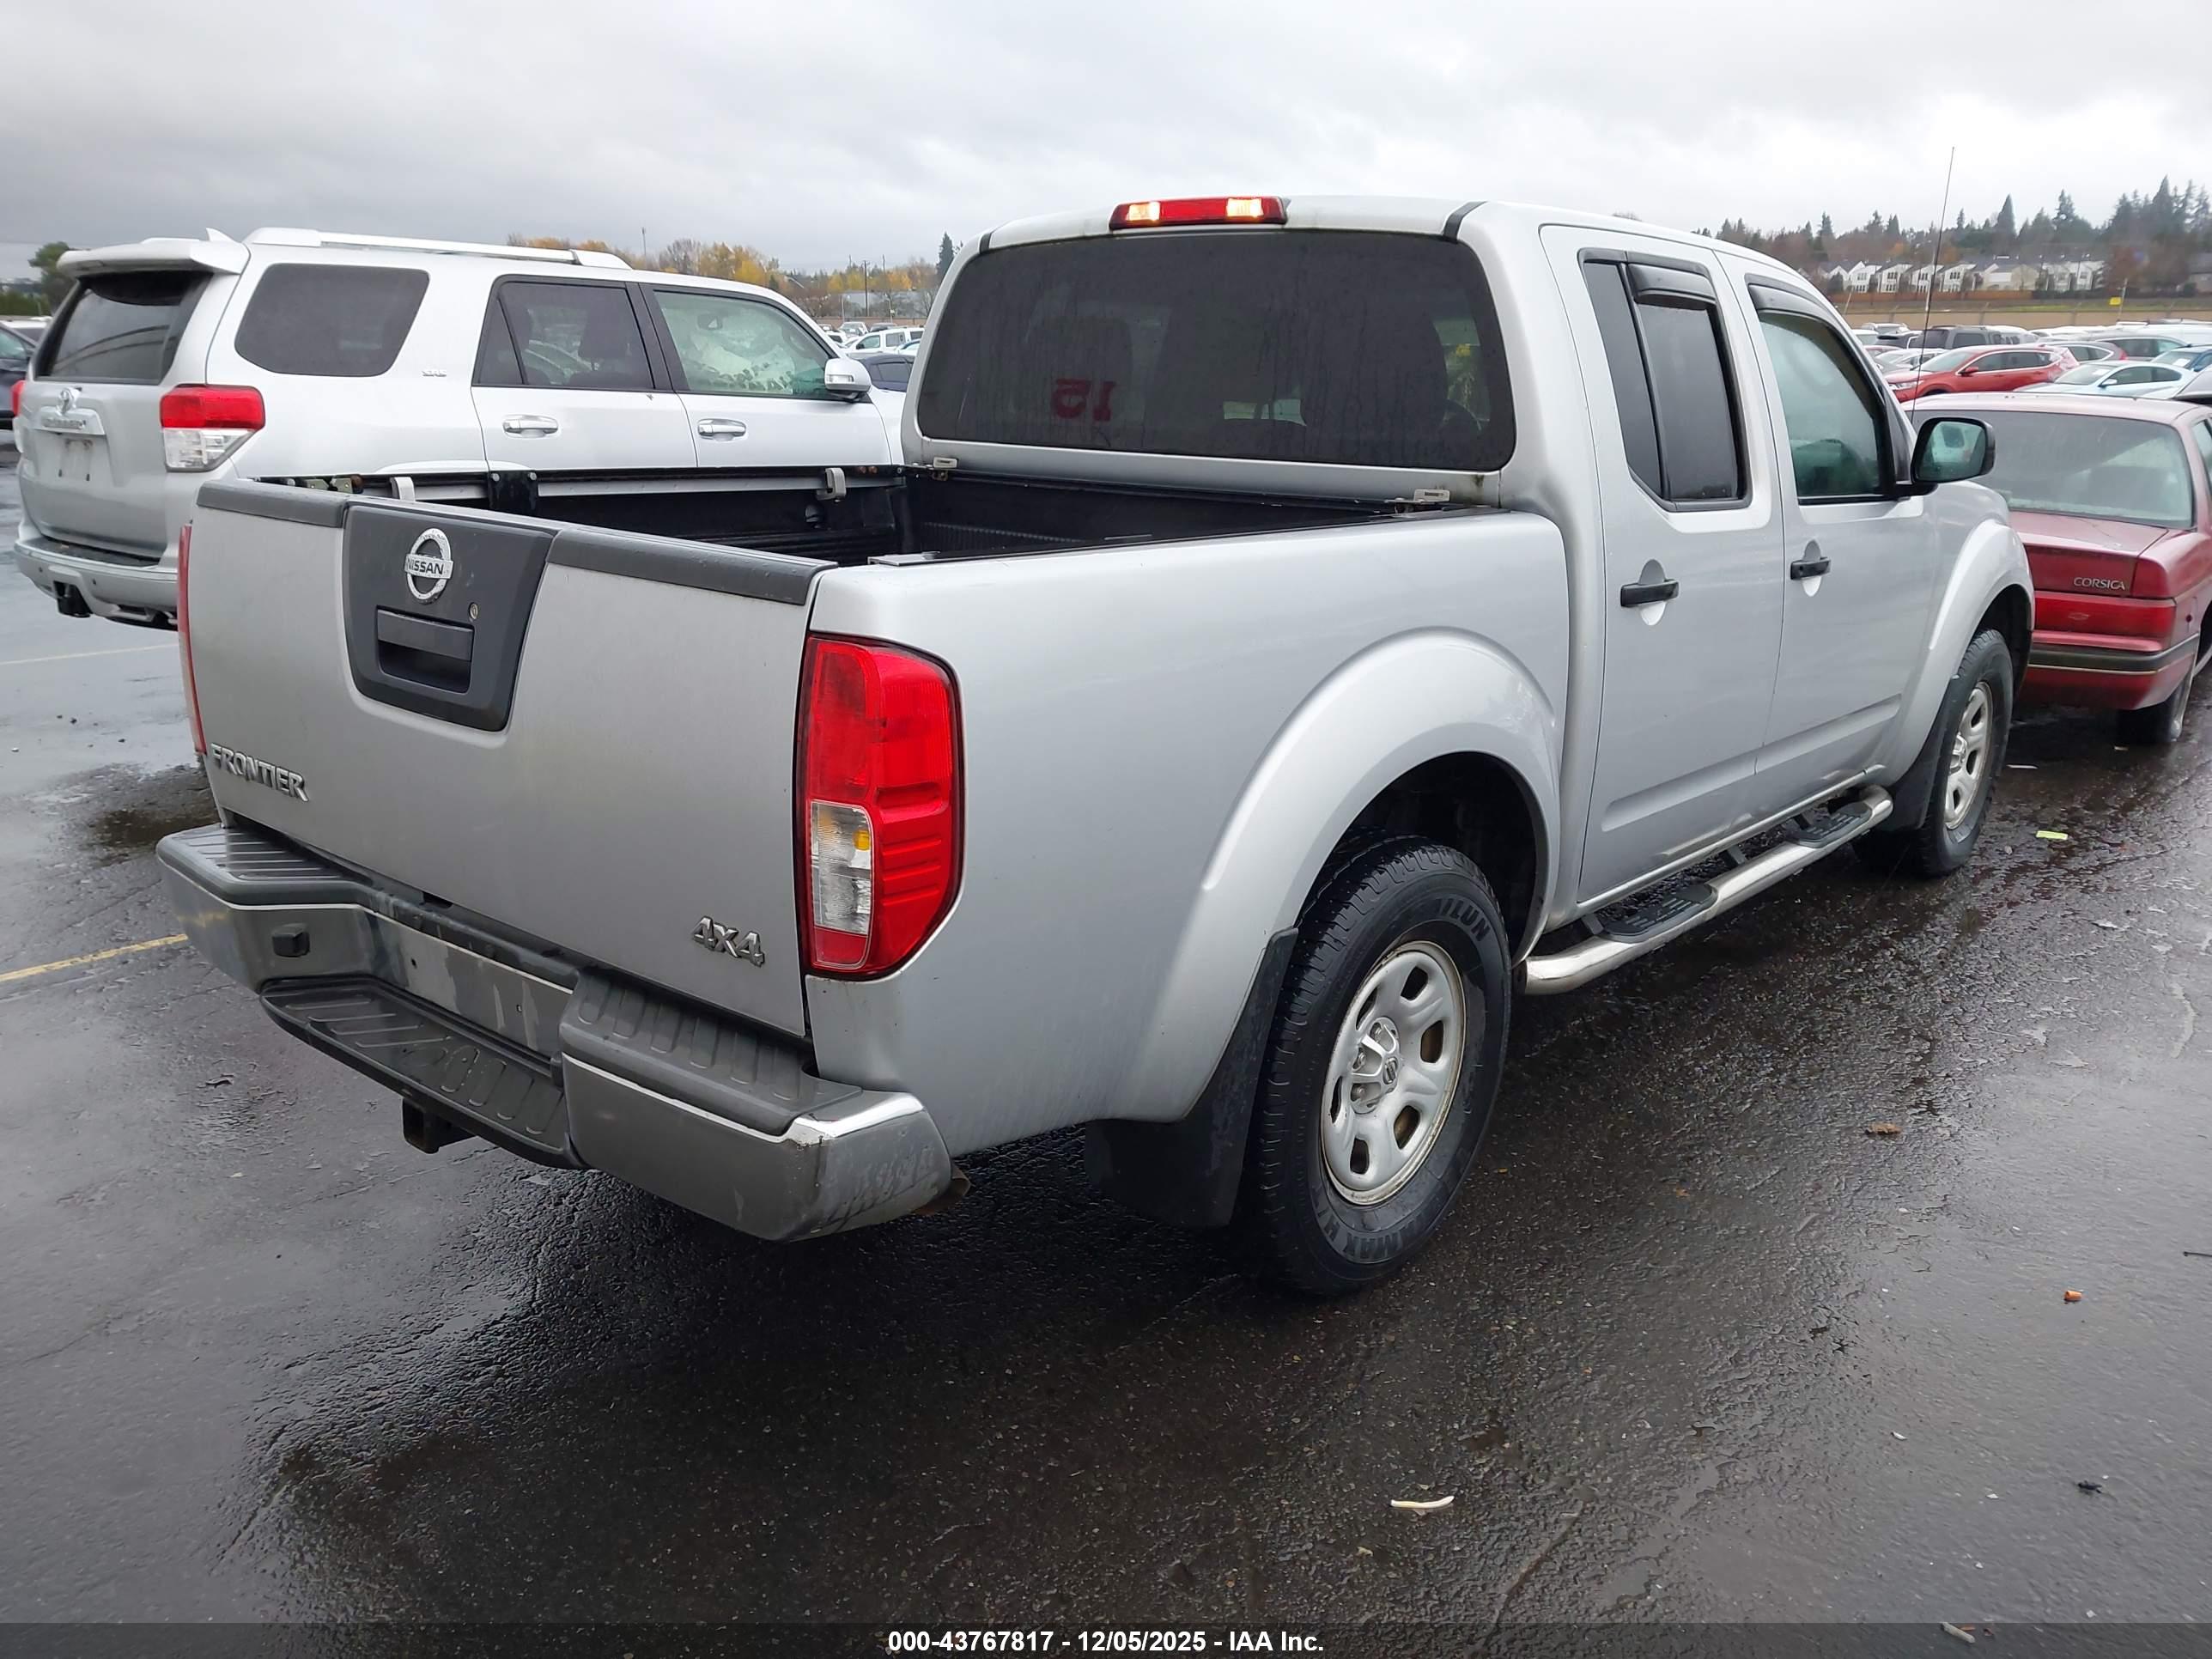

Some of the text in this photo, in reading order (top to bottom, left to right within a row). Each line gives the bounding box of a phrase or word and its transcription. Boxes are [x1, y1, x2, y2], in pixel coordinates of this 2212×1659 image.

[407, 556, 444, 575] NISSAN
[2073, 576, 2126, 592] CORSICA
[210, 743, 309, 802] FRONTIER
[690, 915, 765, 968] 4X4
